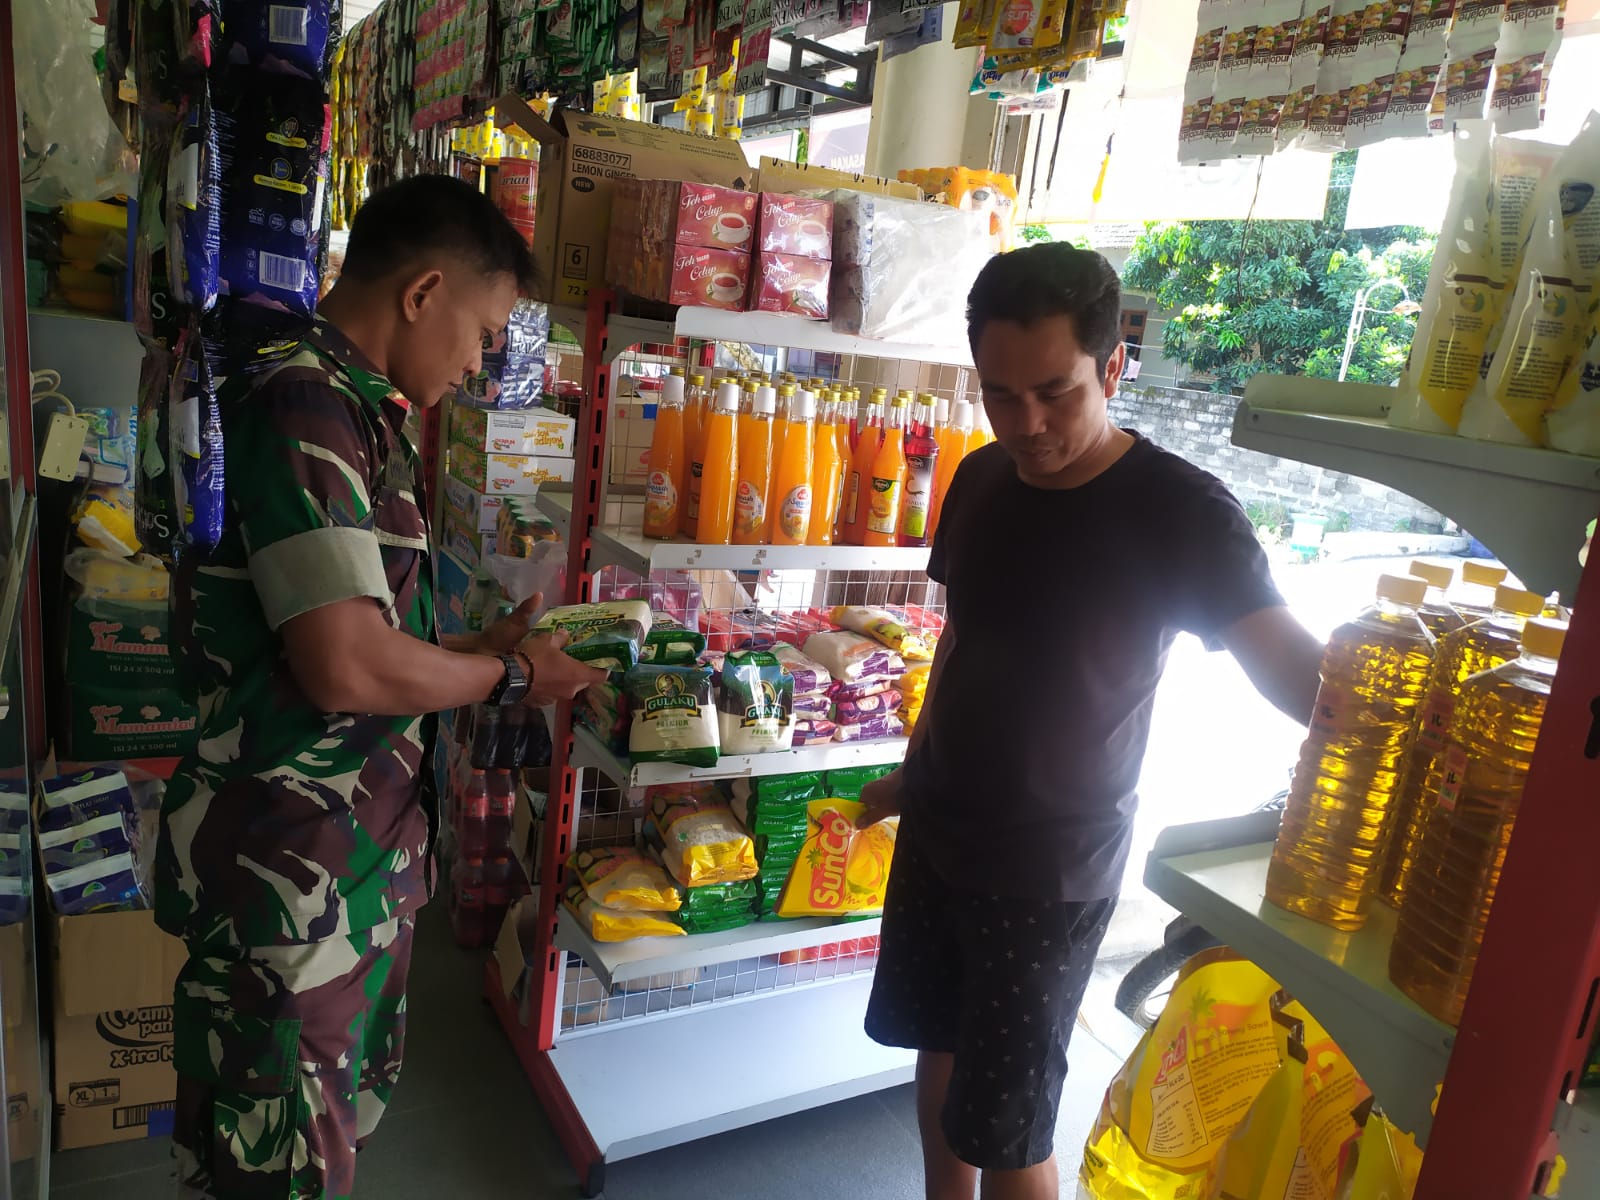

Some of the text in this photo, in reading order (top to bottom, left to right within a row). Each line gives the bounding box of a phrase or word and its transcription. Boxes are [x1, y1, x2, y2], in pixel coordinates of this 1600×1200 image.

[574, 146, 629, 167] 68883077
[572, 162, 603, 177] LEMON
[572, 249, 581, 264] 6
[568, 285, 581, 295] 72
[648, 696, 694, 711] GULAKU
[813, 817, 850, 906] SunCo
[110, 1047, 159, 1068] X-tra
[76, 1090, 89, 1101] XL
